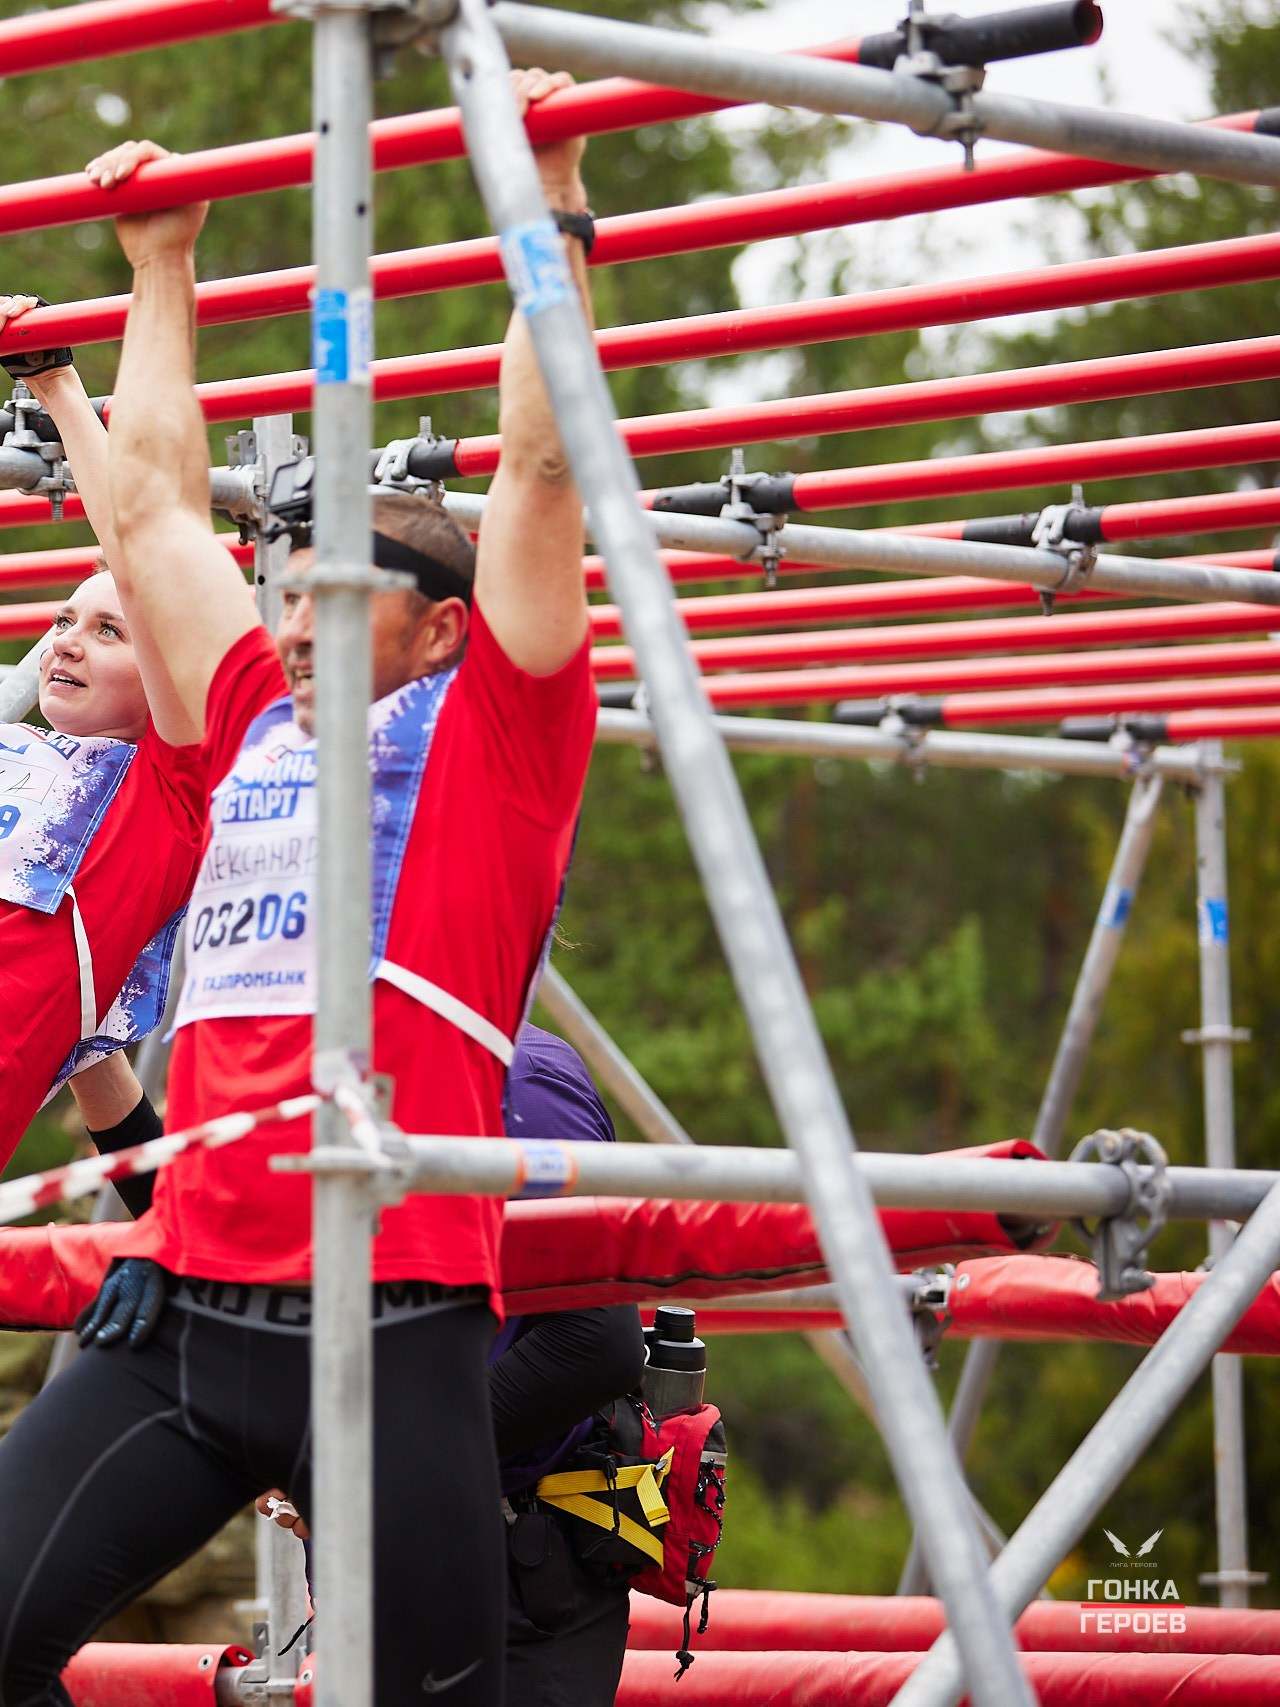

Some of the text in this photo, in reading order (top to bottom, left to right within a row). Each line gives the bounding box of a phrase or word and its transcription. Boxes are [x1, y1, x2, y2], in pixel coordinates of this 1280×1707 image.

[221, 786, 297, 822] СТАРТ
[204, 836, 320, 884] ЛЕКСАНДР
[192, 891, 308, 953] 03206
[201, 970, 307, 992] ГАЗПРОМБАНК
